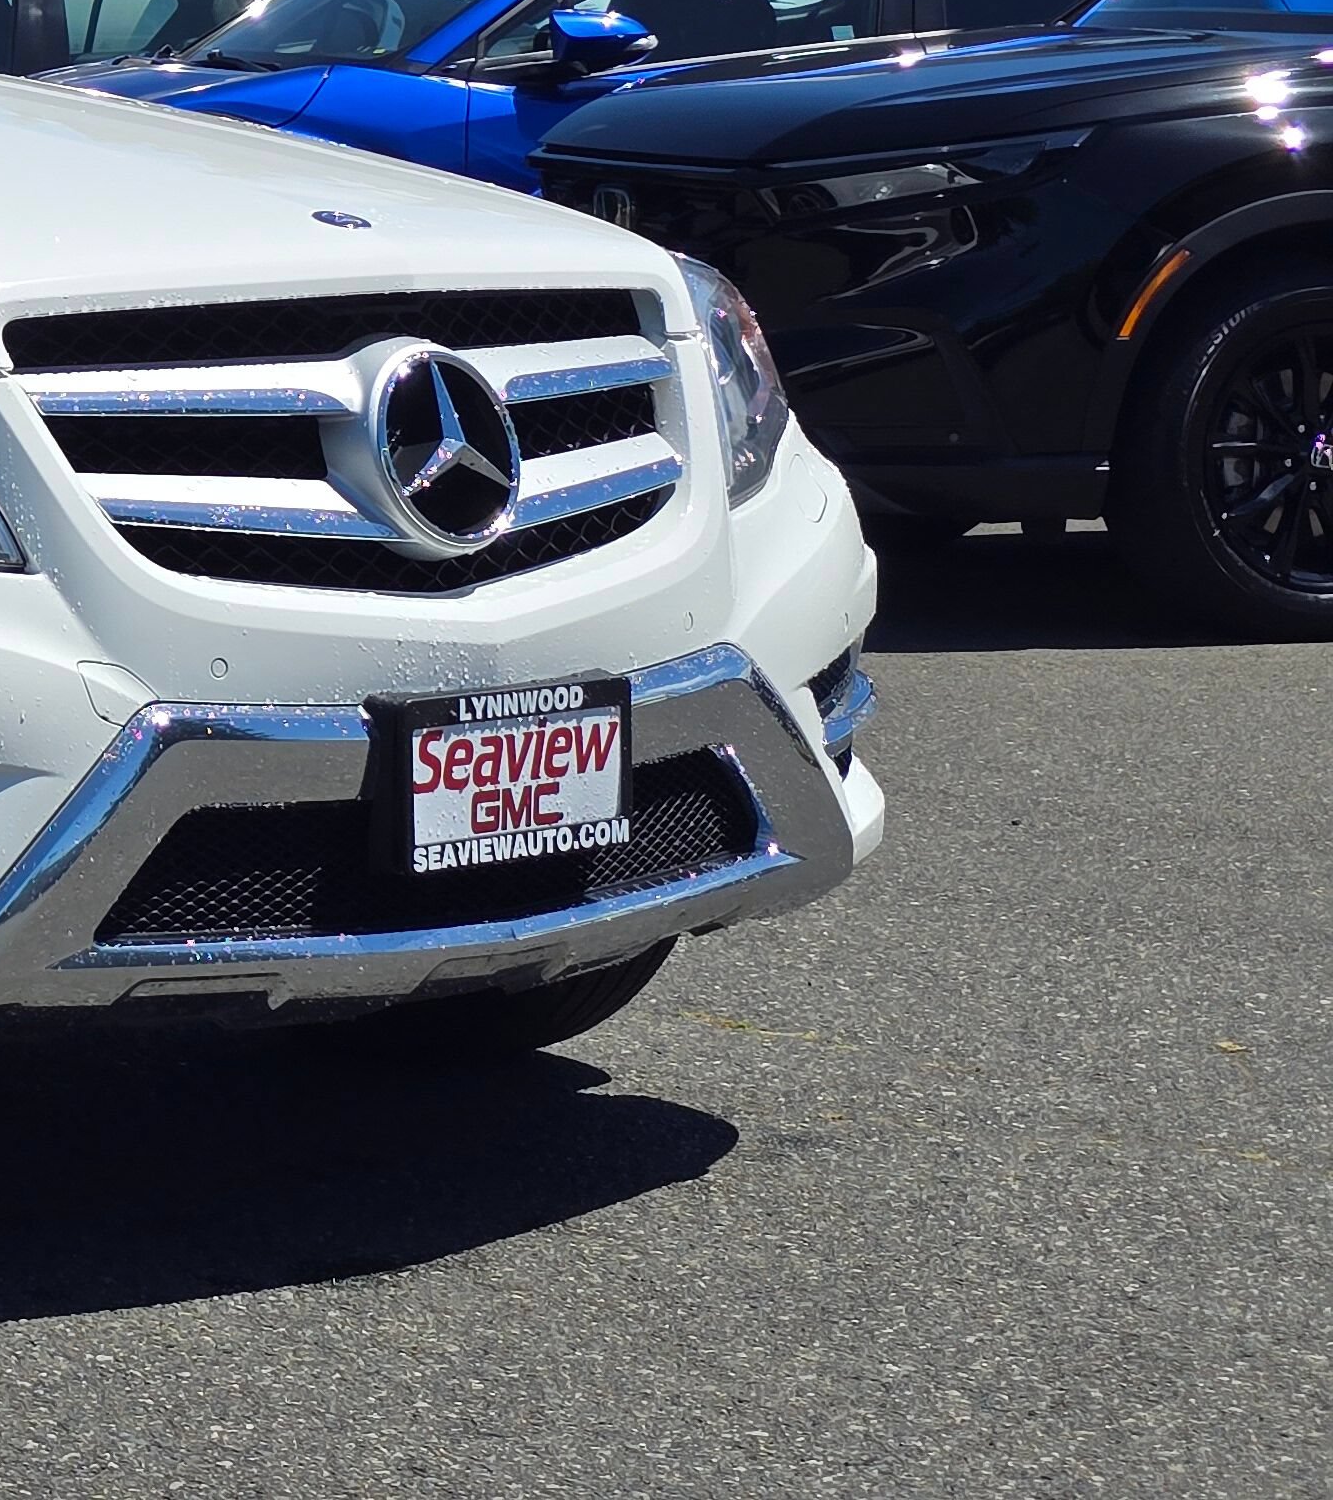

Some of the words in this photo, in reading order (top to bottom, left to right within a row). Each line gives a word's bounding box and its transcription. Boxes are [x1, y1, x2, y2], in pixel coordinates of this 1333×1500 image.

[459, 686, 584, 722] LYNNWOOD
[413, 717, 618, 794] Seaview
[470, 781, 564, 835] GMC
[413, 818, 630, 874] SEAVIEWAUTO.COM
